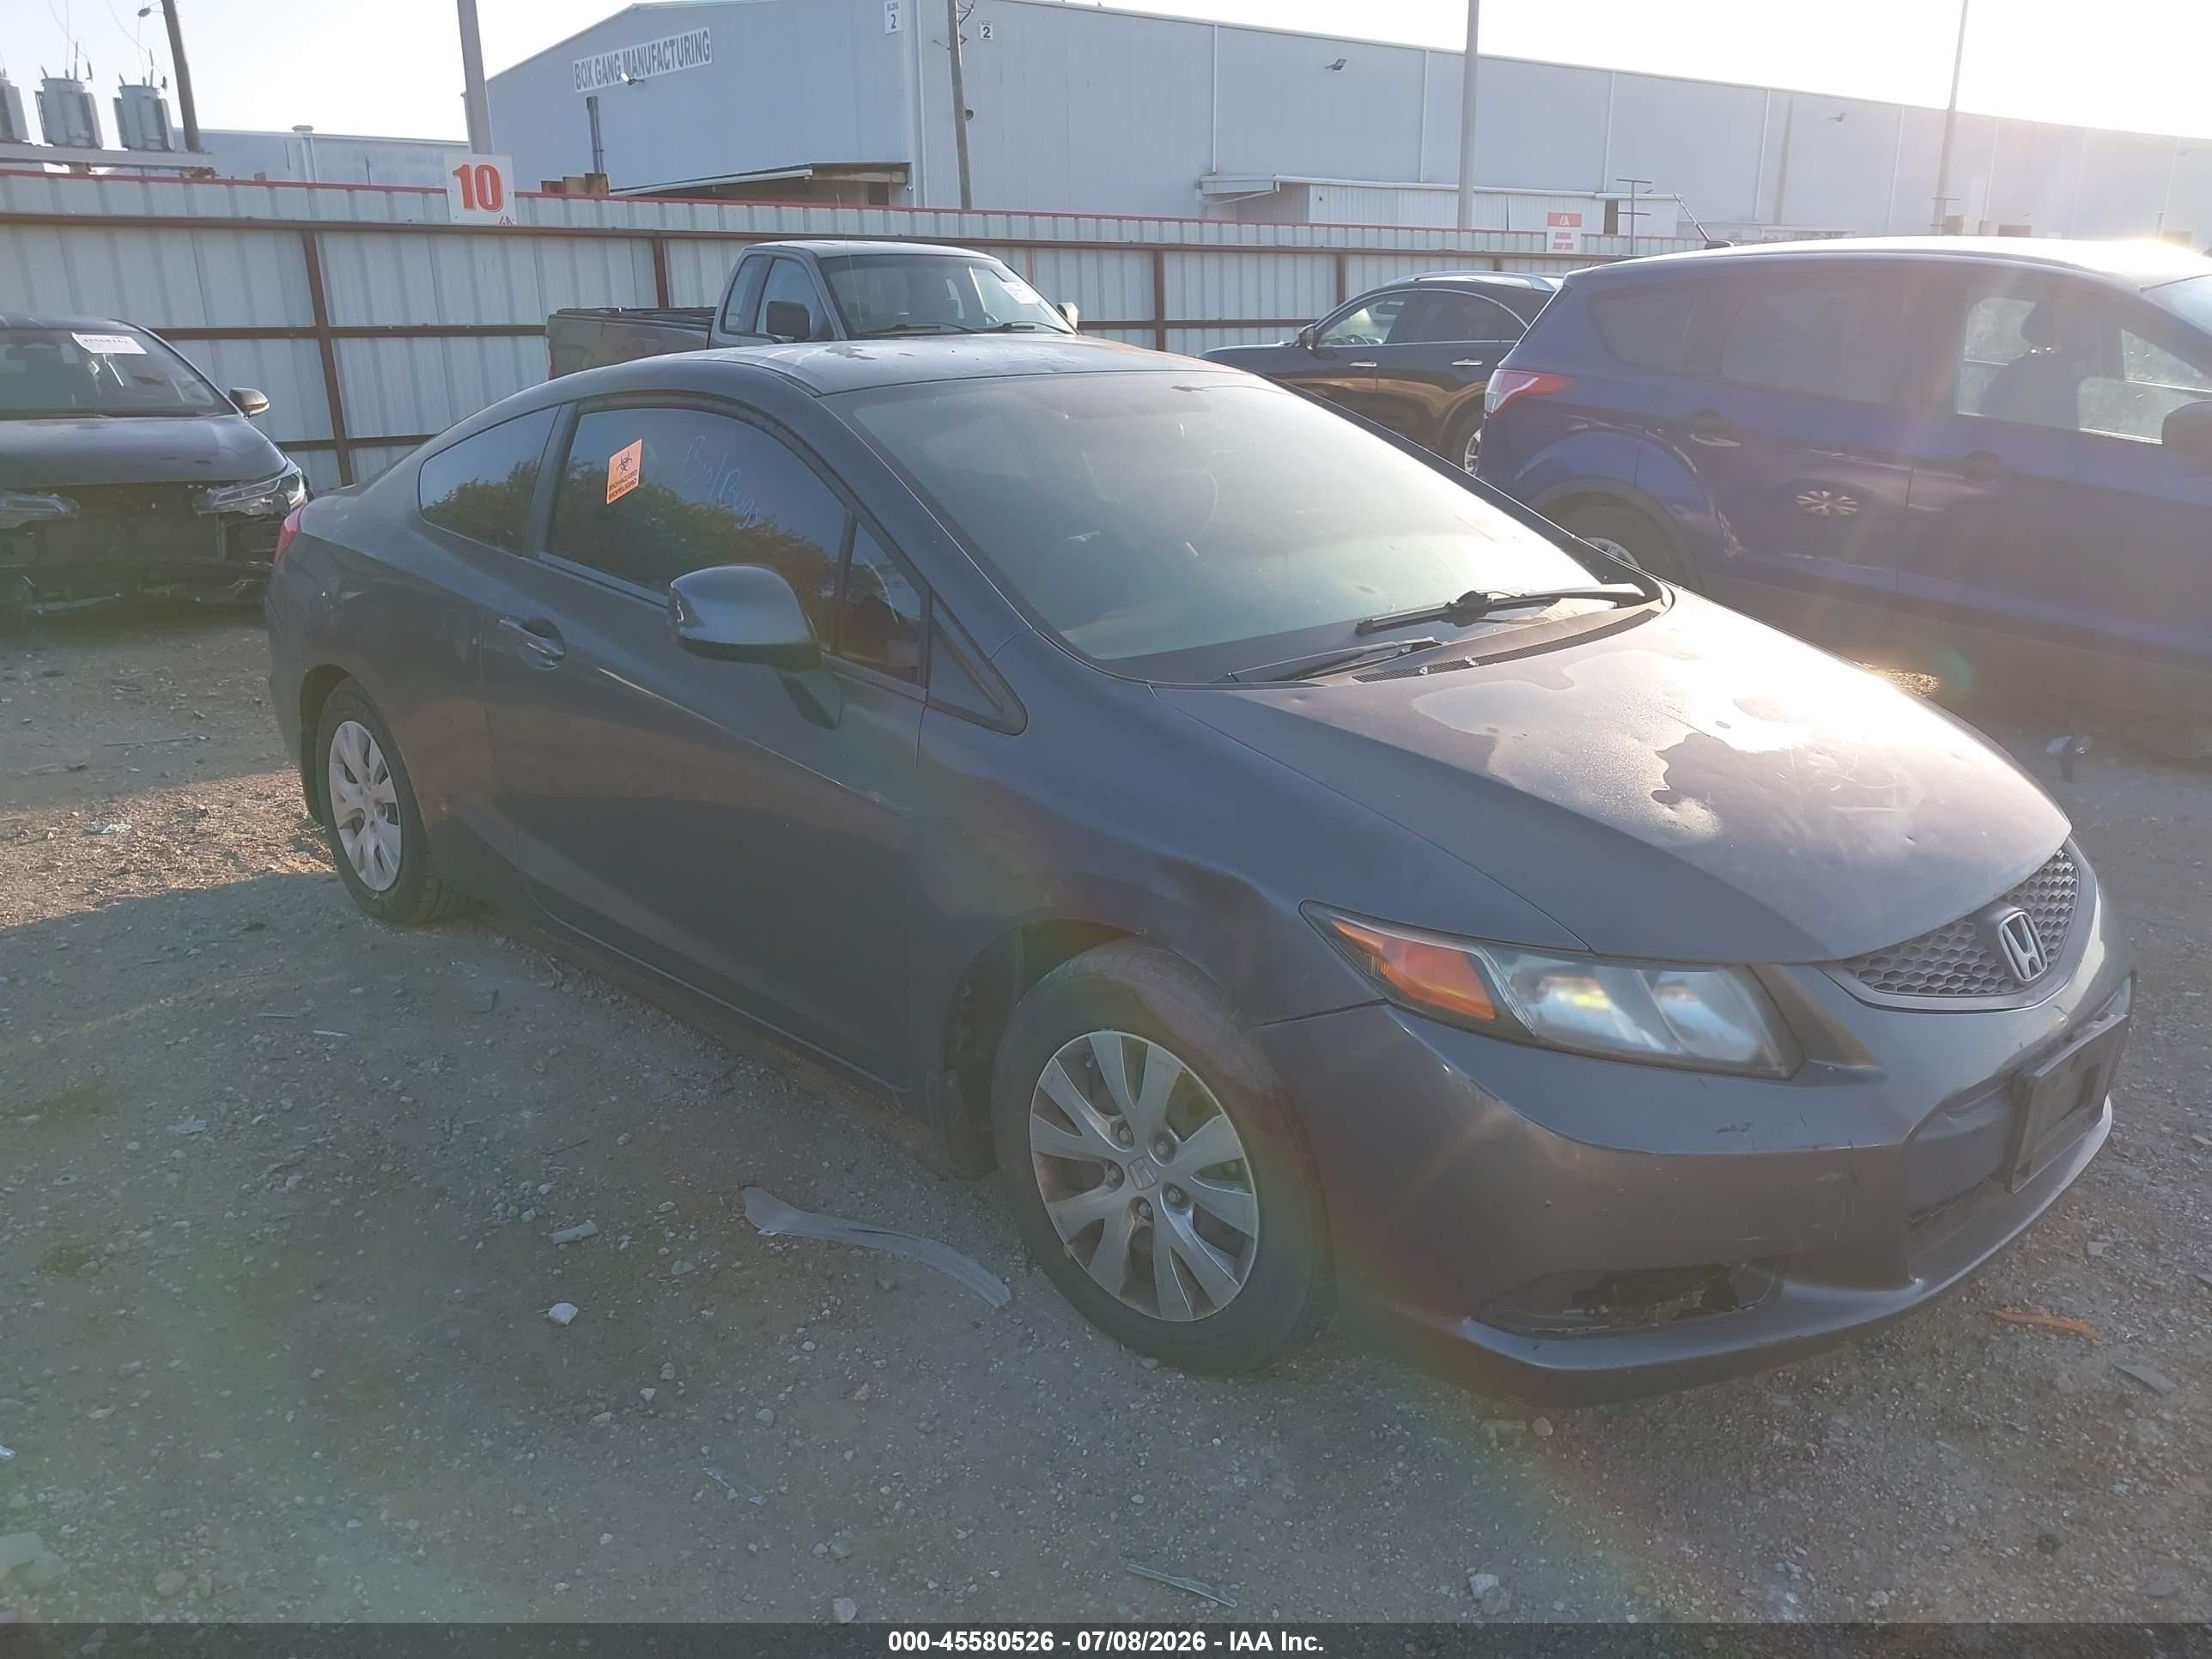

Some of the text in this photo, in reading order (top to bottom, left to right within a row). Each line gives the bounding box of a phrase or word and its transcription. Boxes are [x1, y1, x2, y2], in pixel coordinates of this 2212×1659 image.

[890, 14, 896, 29] 2
[982, 27, 991, 39] 2
[574, 30, 711, 89] BOX GANG MANUFACTURING
[453, 164, 504, 213] 10
